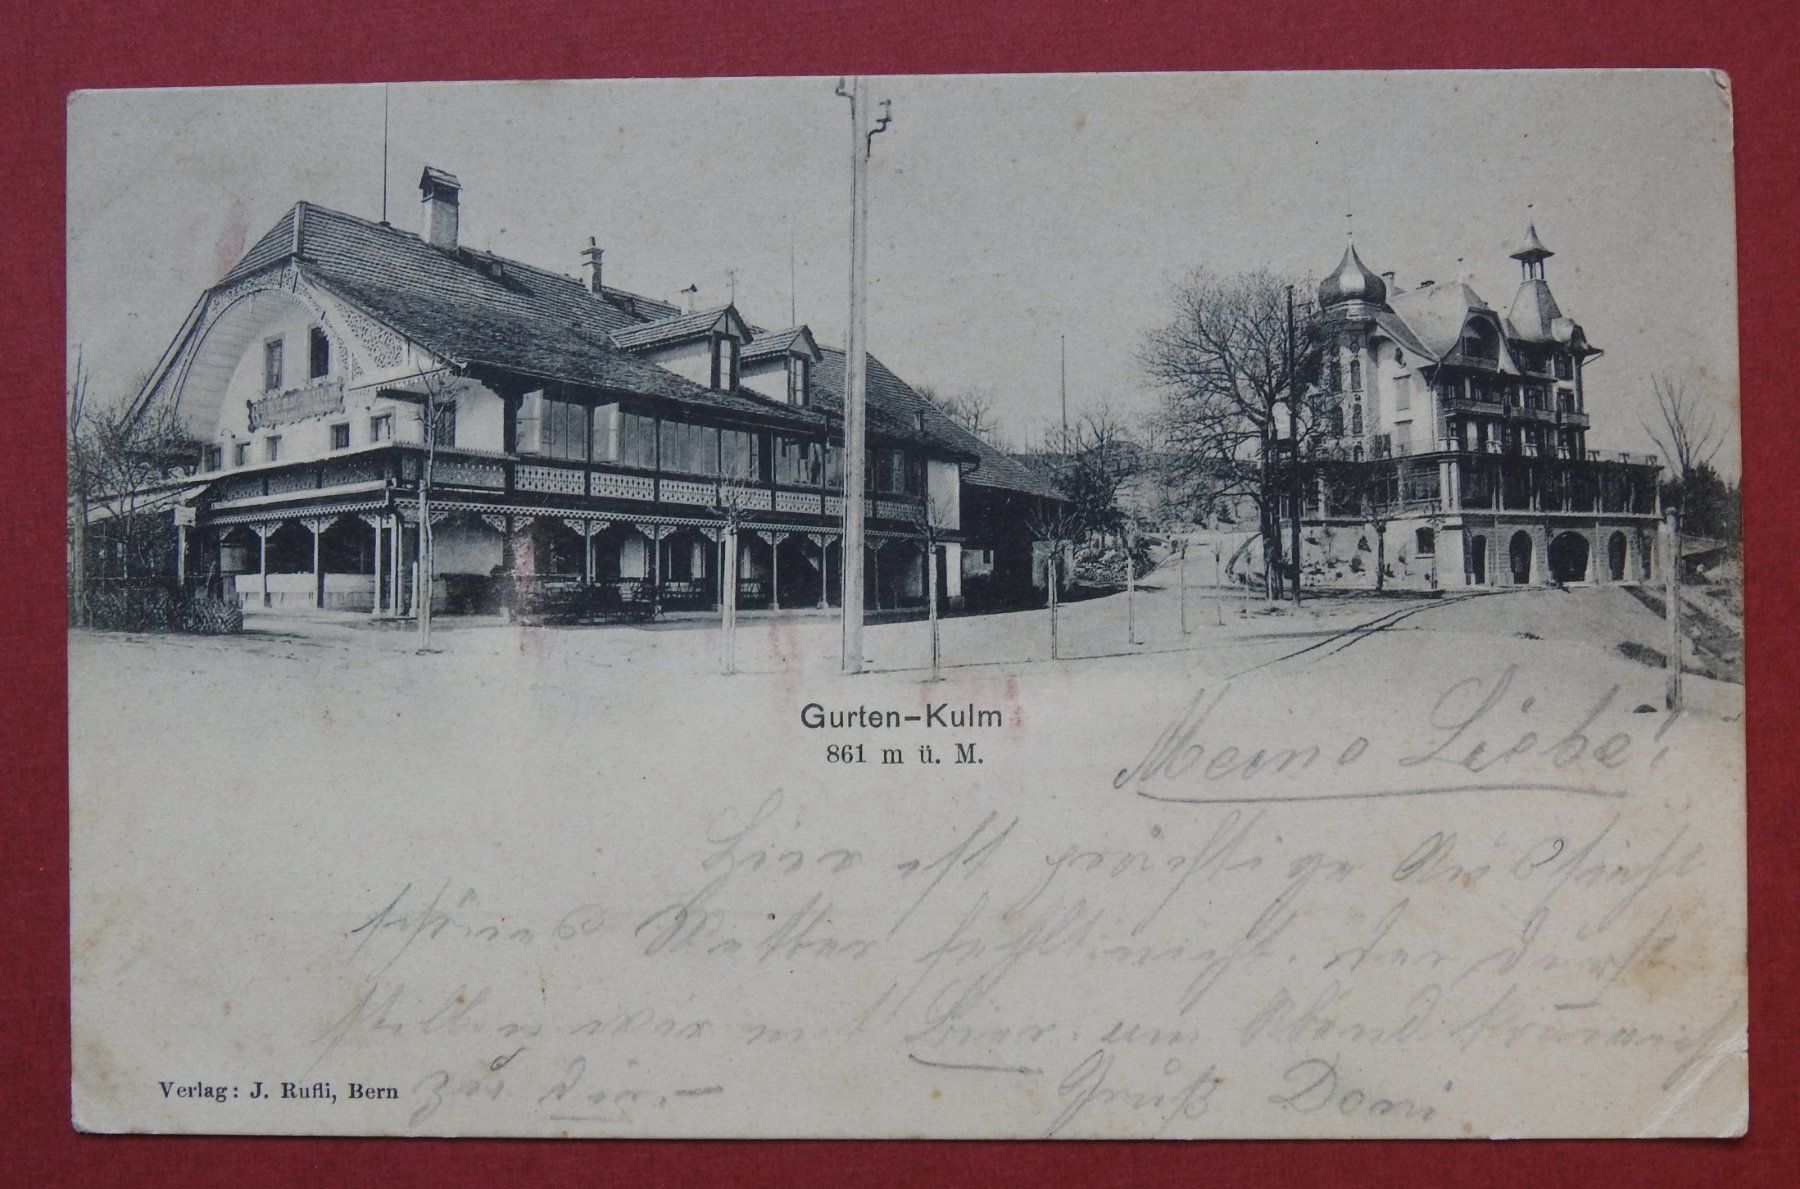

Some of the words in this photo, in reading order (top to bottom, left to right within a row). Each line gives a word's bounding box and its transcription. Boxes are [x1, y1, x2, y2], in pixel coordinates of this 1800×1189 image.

[800, 702, 1003, 729] Gurten-Kulm
[826, 744, 867, 764] 861
[881, 748, 905, 764] m
[918, 744, 941, 764] ü.
[955, 743, 984, 764] M.
[158, 1081, 239, 1103] Verlag:
[249, 1081, 269, 1099] J.
[281, 1082, 338, 1104] Rufli,
[347, 1082, 399, 1100] Bern
